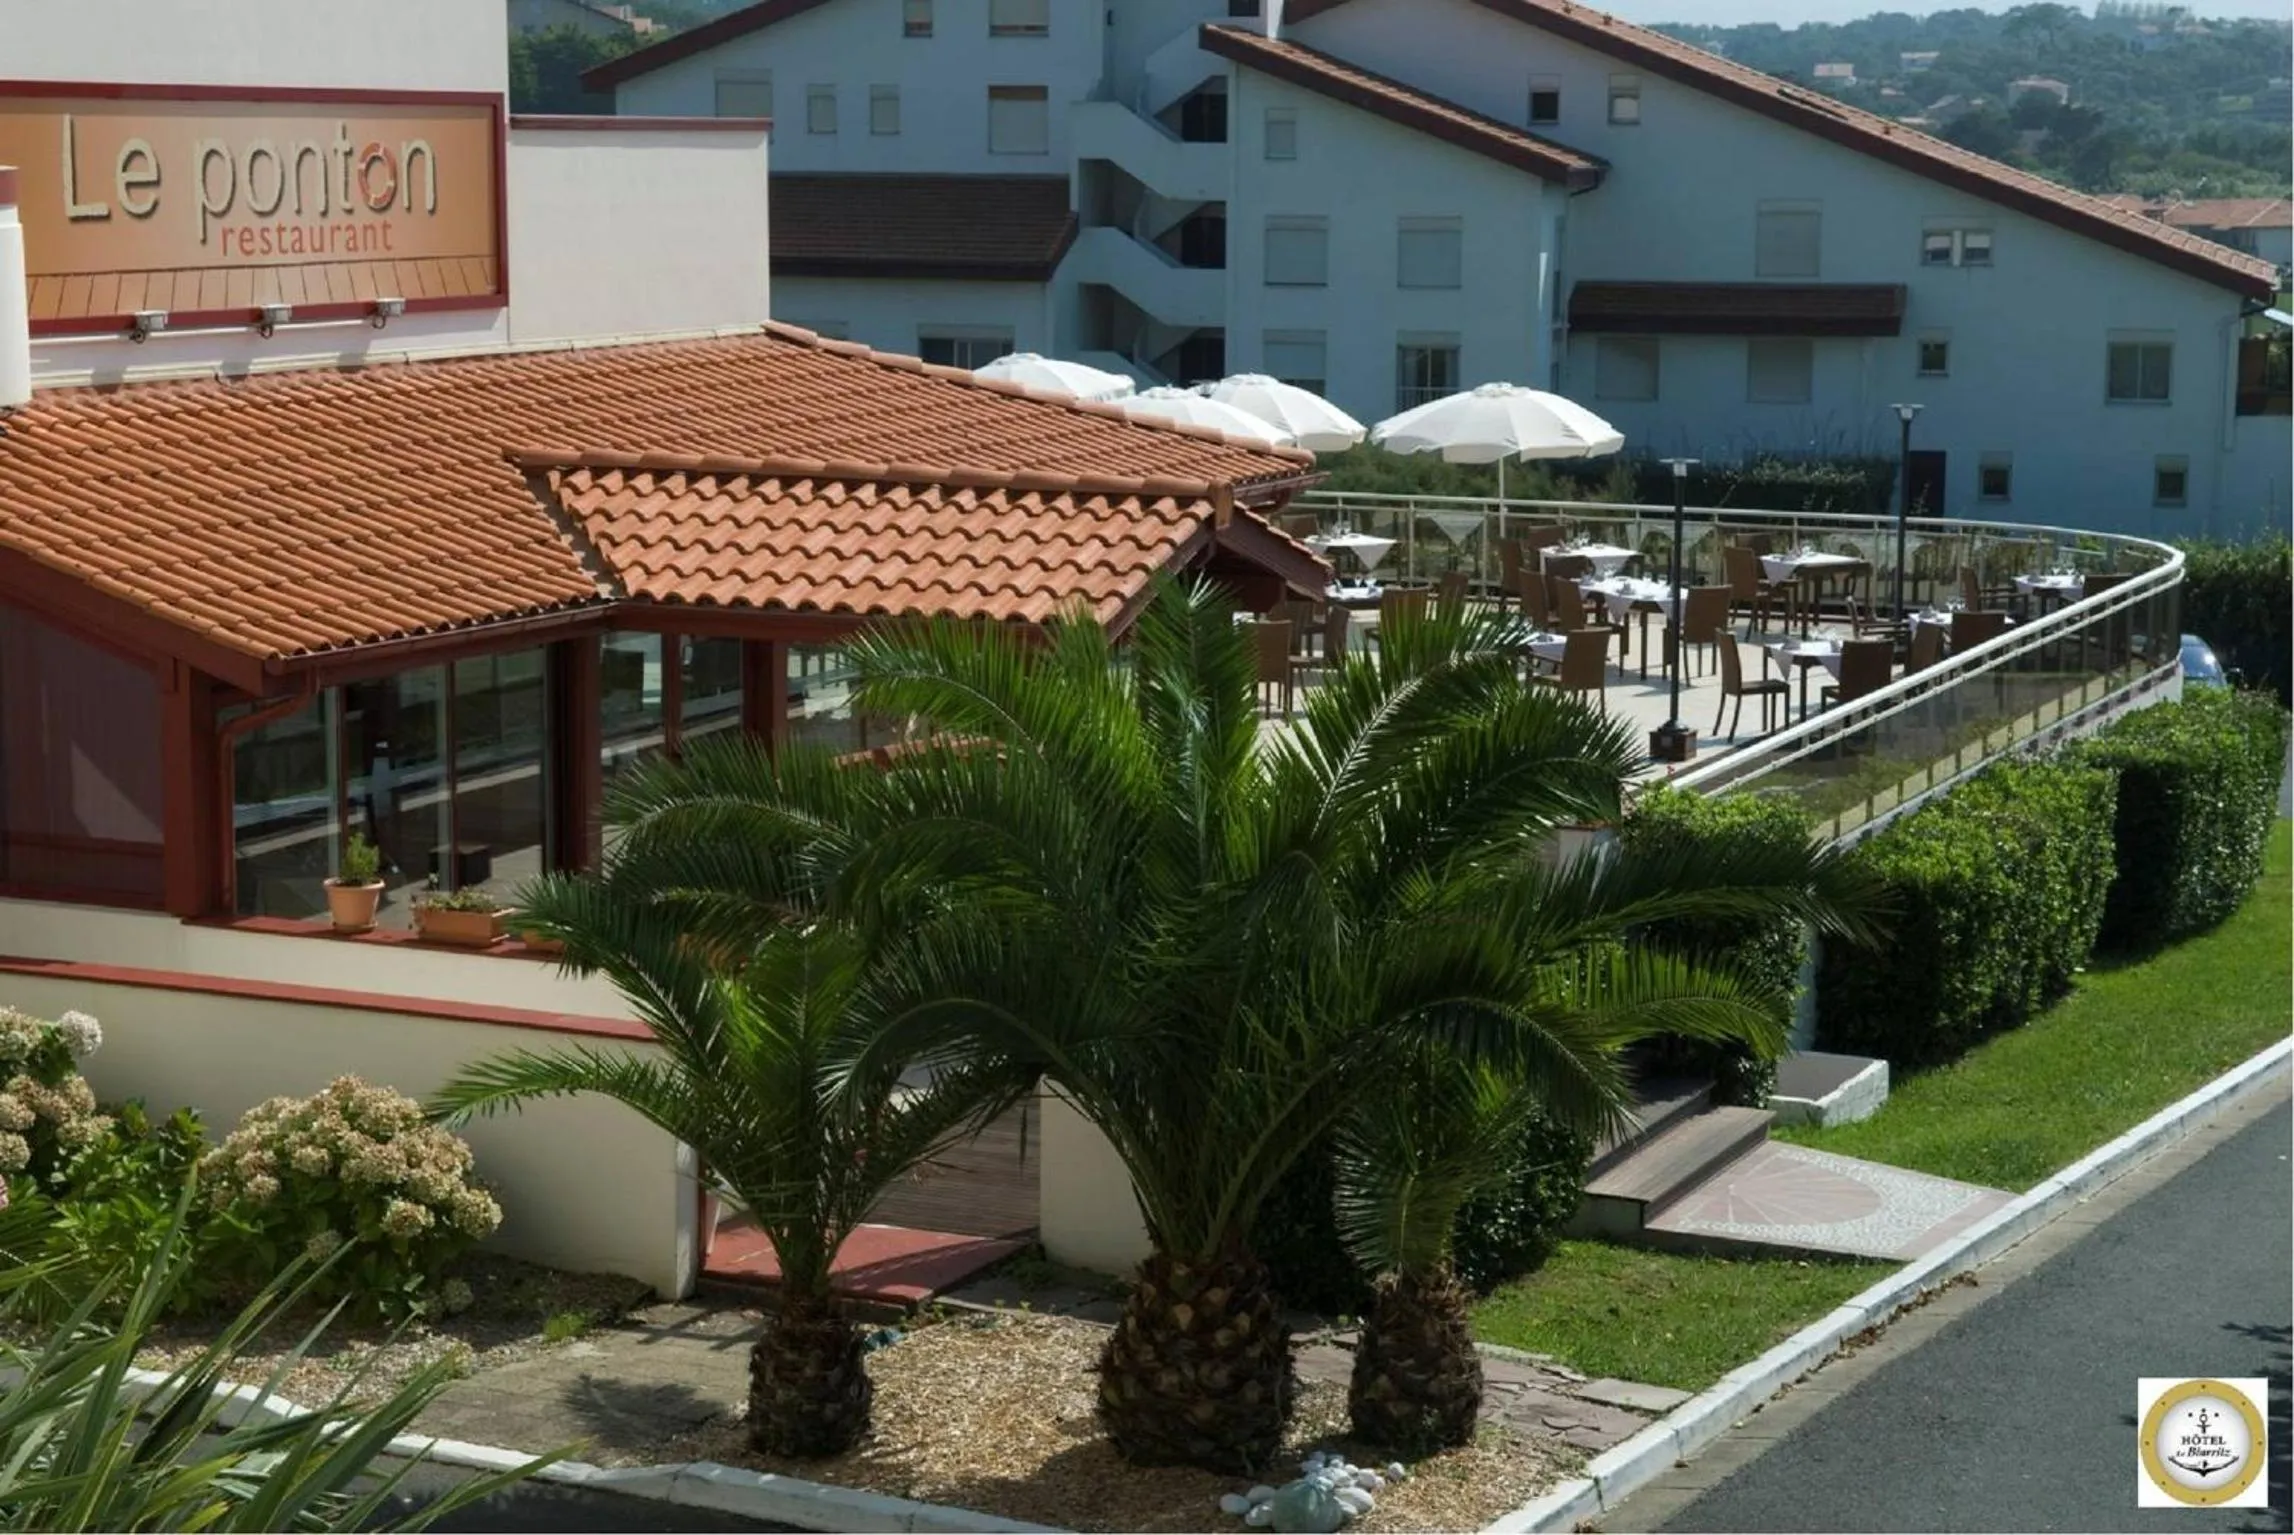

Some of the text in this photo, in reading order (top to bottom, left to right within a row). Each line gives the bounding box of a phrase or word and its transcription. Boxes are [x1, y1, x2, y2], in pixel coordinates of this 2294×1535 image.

[62, 113, 437, 245] Le ponton
[221, 218, 395, 256] restaurant
